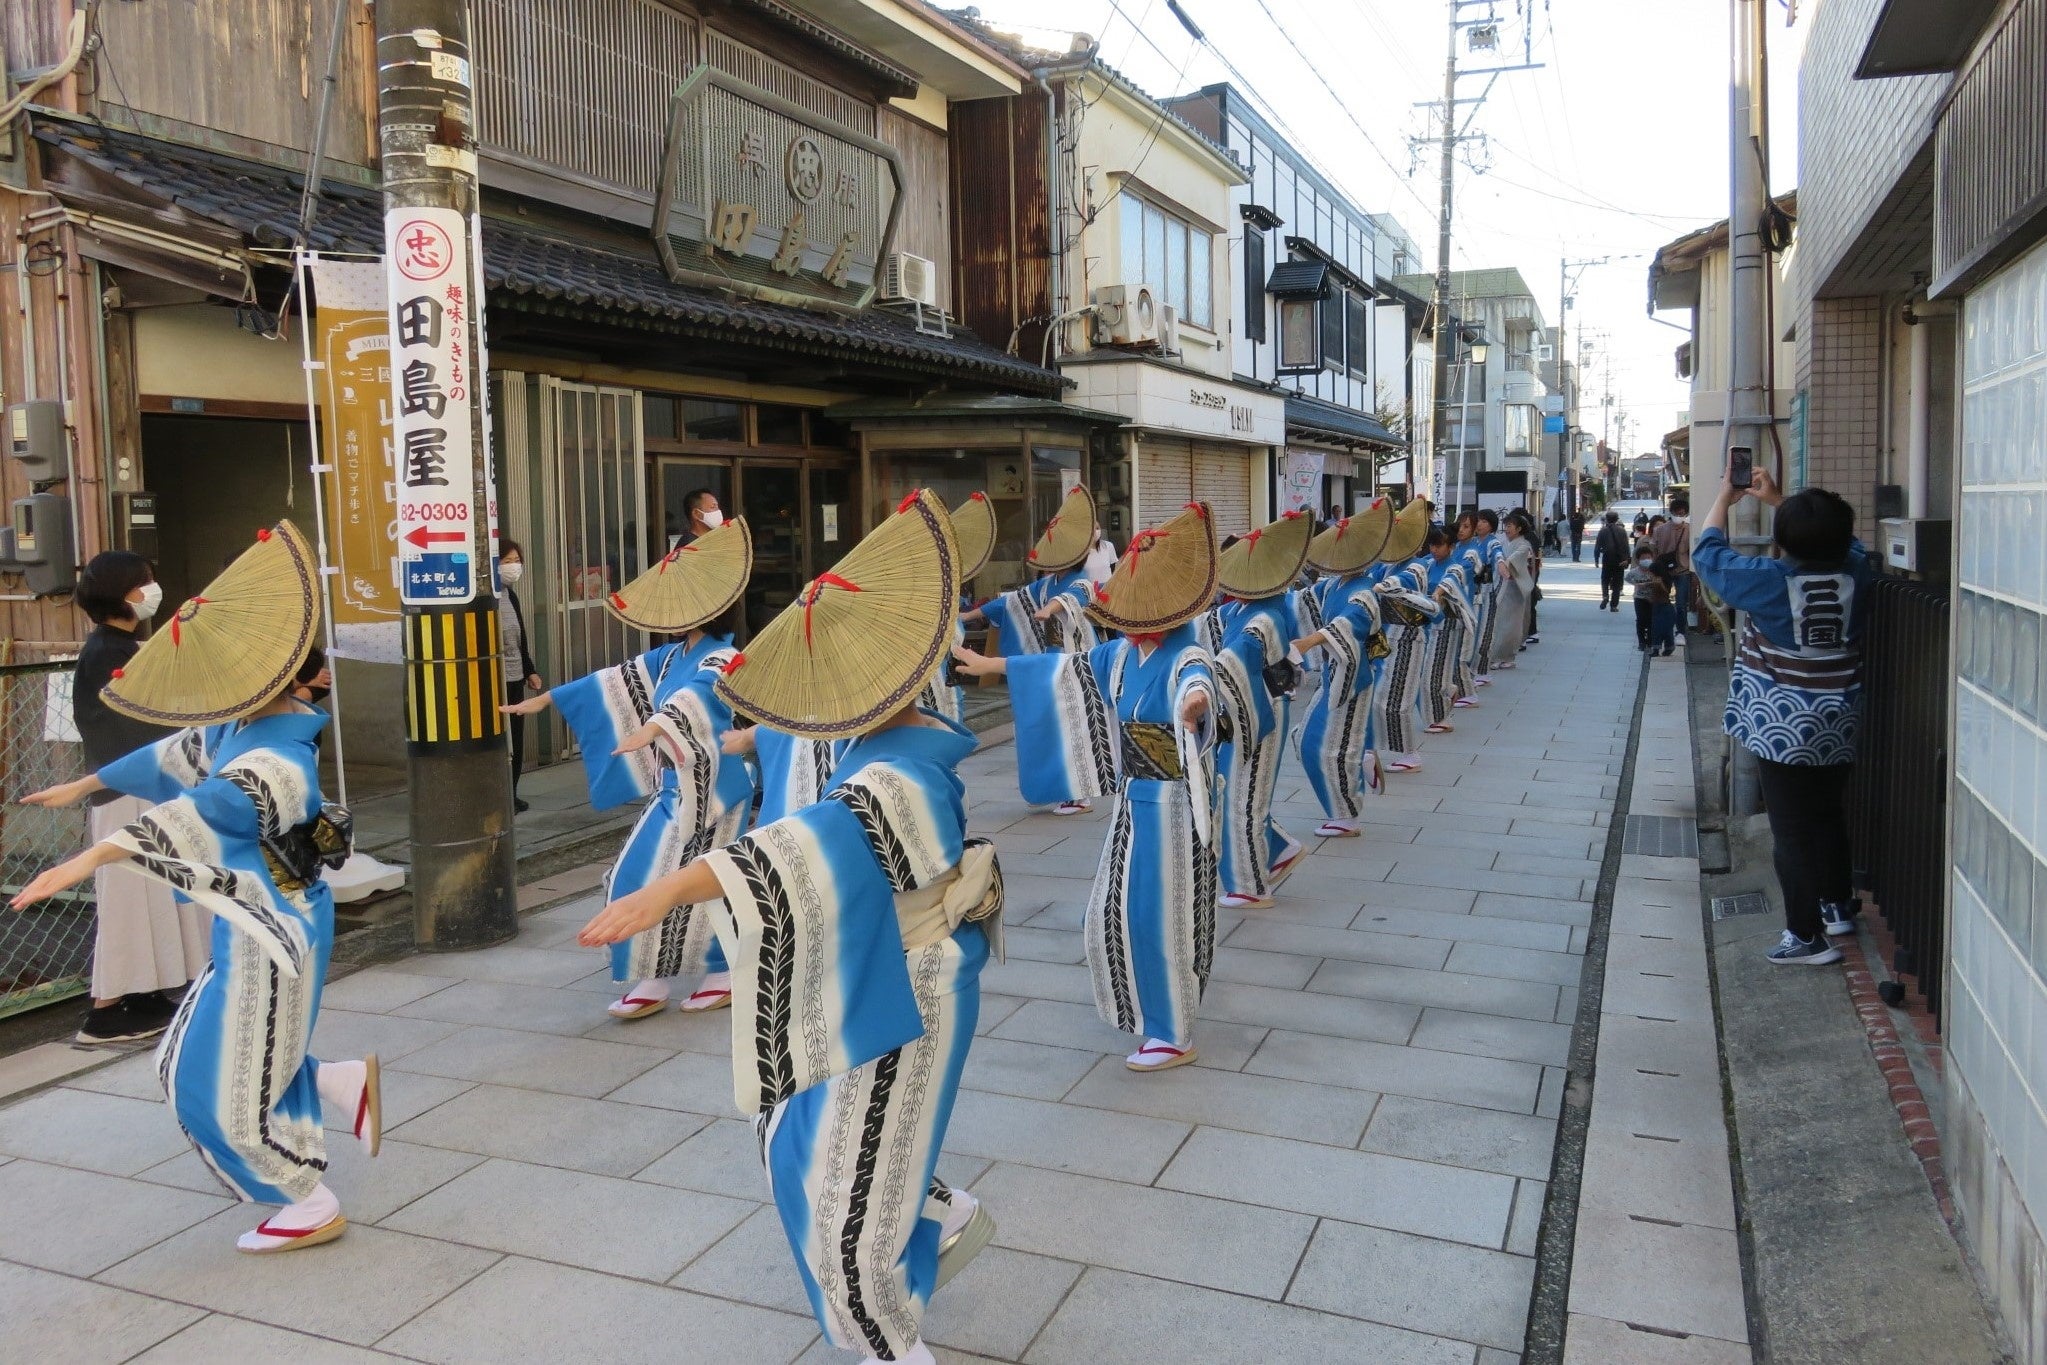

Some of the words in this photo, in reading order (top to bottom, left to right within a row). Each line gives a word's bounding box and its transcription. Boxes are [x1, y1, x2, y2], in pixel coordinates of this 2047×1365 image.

[405, 228, 440, 268] 忠
[361, 338, 390, 349] MIK
[446, 284, 465, 401] 趣味のきもの
[397, 295, 449, 488] 田島屋
[345, 429, 361, 524] 着物でマチ歩き
[401, 503, 467, 521] 82-0303
[411, 572, 456, 584] 北本町4
